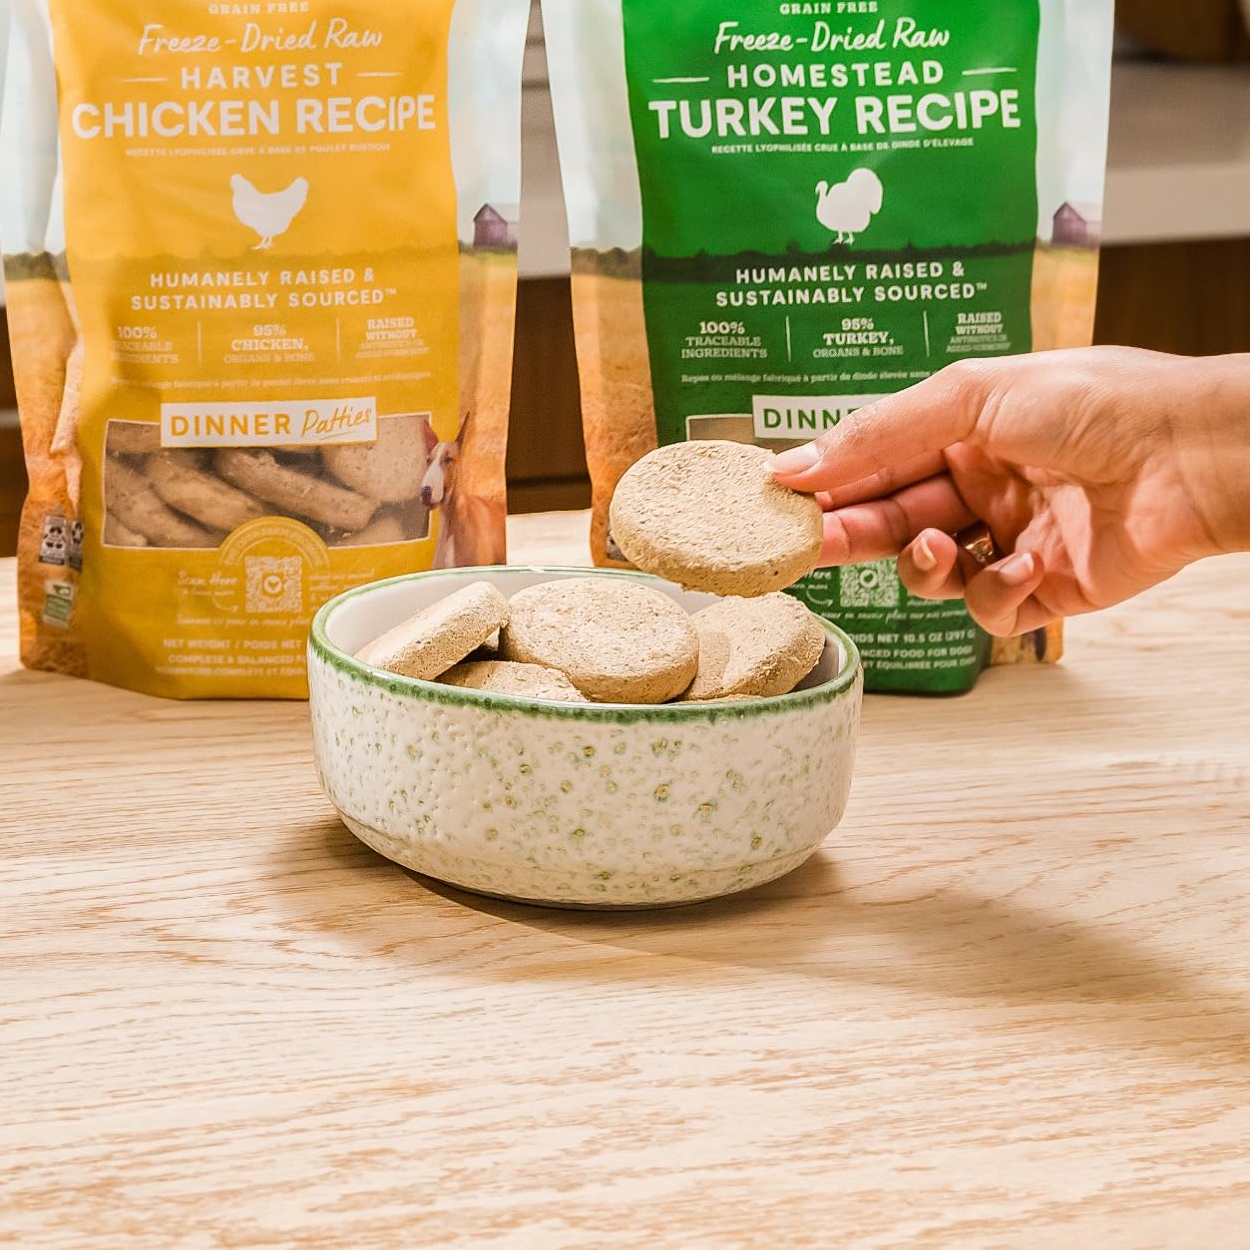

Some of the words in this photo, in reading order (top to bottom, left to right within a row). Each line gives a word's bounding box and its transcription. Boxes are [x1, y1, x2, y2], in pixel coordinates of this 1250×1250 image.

[209, 3, 260, 15] GRAIN
[267, 2, 309, 13] FREE
[779, 3, 831, 15] GRAIN
[837, 1, 878, 13] FREE
[138, 19, 317, 56] Freeze-Dried
[324, 17, 382, 49] Raw
[715, 18, 886, 54] Freeze-Dried
[892, 17, 949, 48] Raw
[182, 63, 343, 90] HARVEST
[728, 61, 943, 88] HOMESTEAD
[72, 100, 279, 140] CHICKEN
[297, 95, 436, 134] RECIPE
[649, 97, 837, 138] TURKEY
[855, 90, 1020, 134] RECIPE
[814, 143, 838, 152] CRUE
[850, 142, 874, 151] BASE
[876, 142, 889, 150] DE
[150, 271, 270, 287] HUMANELY
[280, 269, 355, 284] RAISED
[364, 268, 374, 281] &
[736, 265, 855, 283] HUMANELY
[866, 262, 943, 279] RAISED
[953, 261, 964, 276] &
[131, 293, 278, 310] SUSTAINABLY
[717, 287, 864, 306] SUSTAINABLY
[367, 318, 414, 330] RAISED
[957, 312, 1001, 324] RAISED
[117, 326, 157, 339] 100%
[700, 322, 745, 334] 100%
[231, 338, 308, 351] CHICKEN,
[685, 336, 761, 346] TRACEABLE
[823, 331, 894, 345] TURKEY,
[682, 348, 767, 358] INGREDIENTS
[813, 347, 860, 358] ORGANS
[171, 414, 290, 437] DINNER
[302, 404, 371, 437] Patties
[763, 408, 861, 429] DINN
